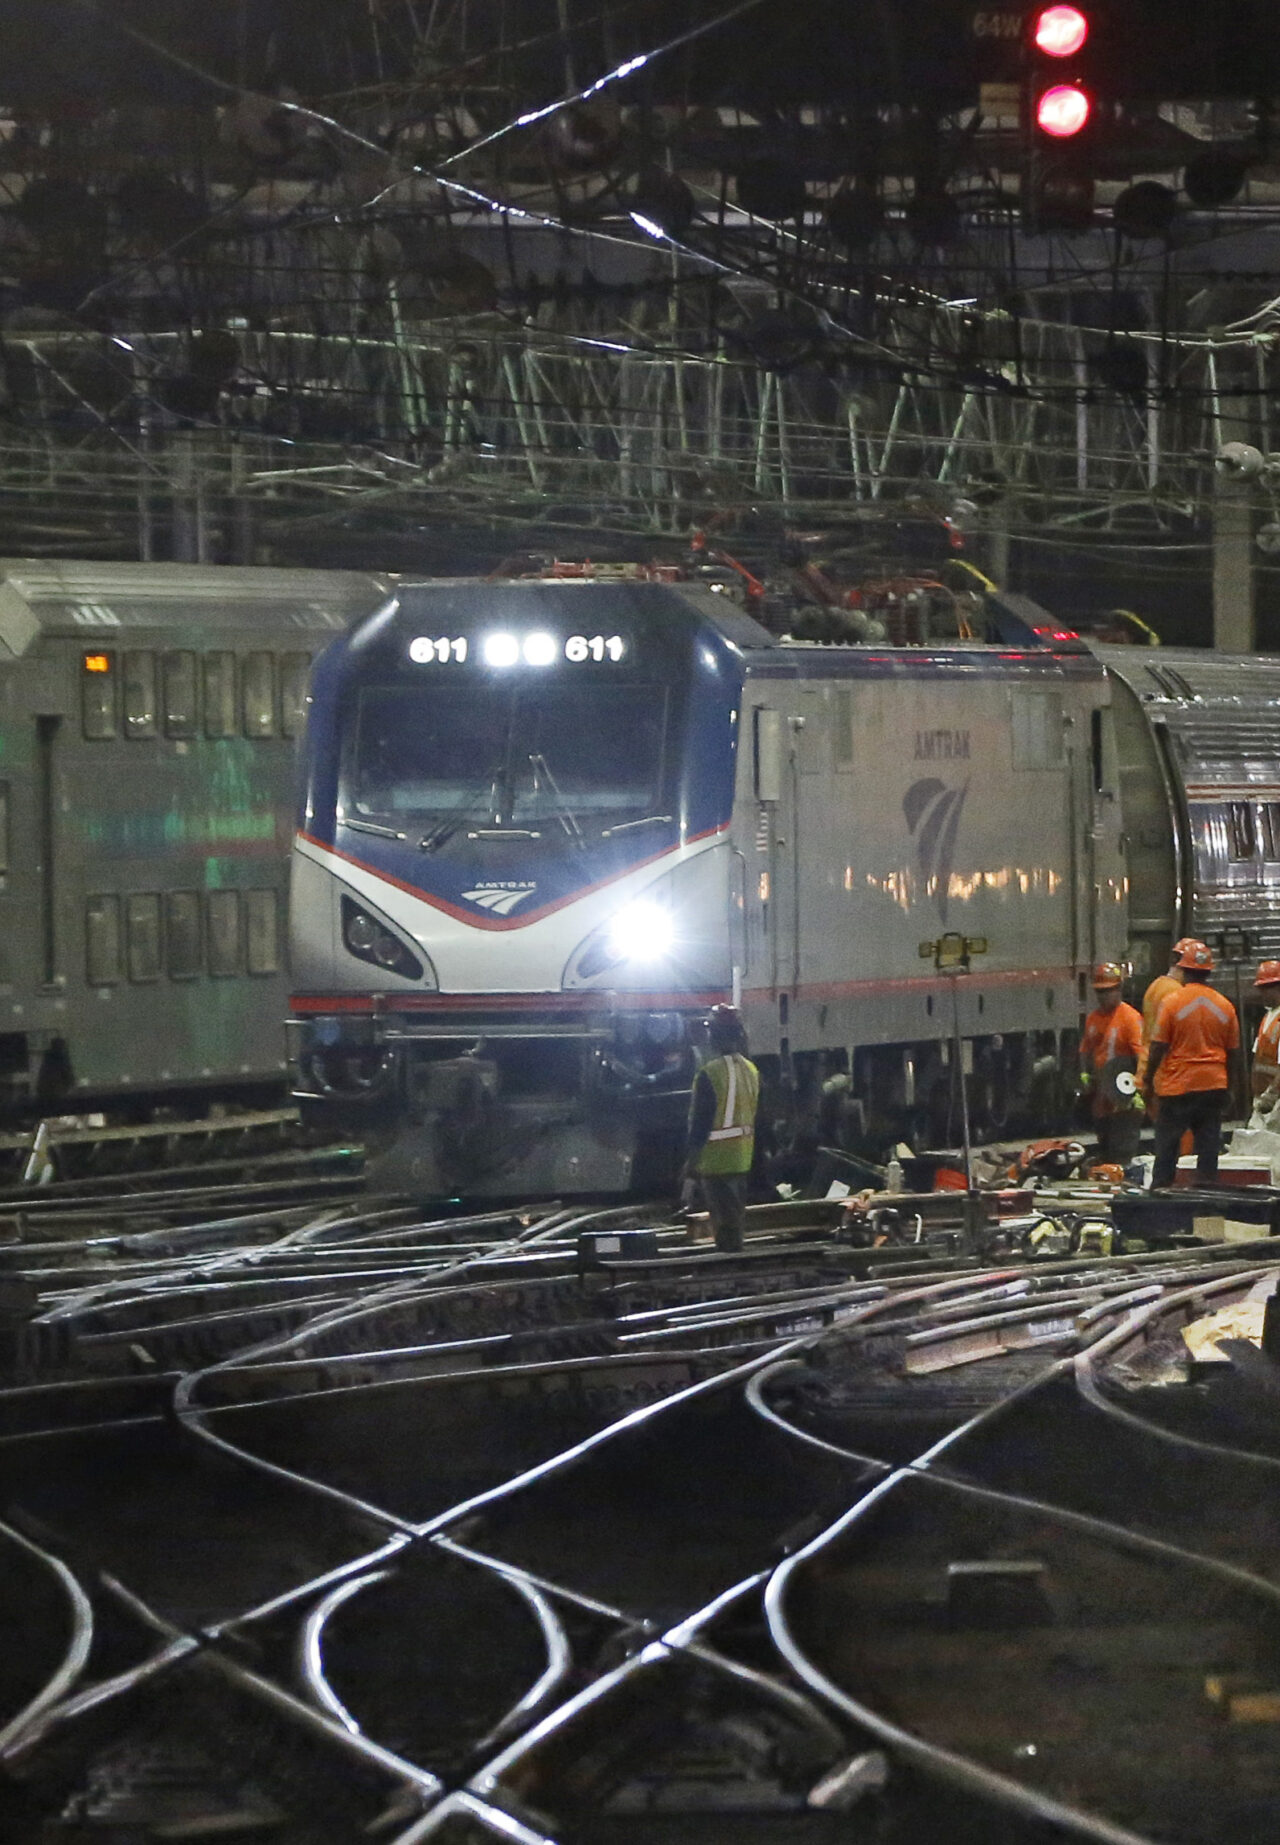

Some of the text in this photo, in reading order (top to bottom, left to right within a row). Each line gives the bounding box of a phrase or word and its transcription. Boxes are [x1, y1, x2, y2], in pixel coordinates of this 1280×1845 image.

[409, 637, 467, 664] 611
[564, 635, 623, 662] 611
[914, 730, 971, 760] AMTRAK
[475, 881, 537, 889] AMTRAK
